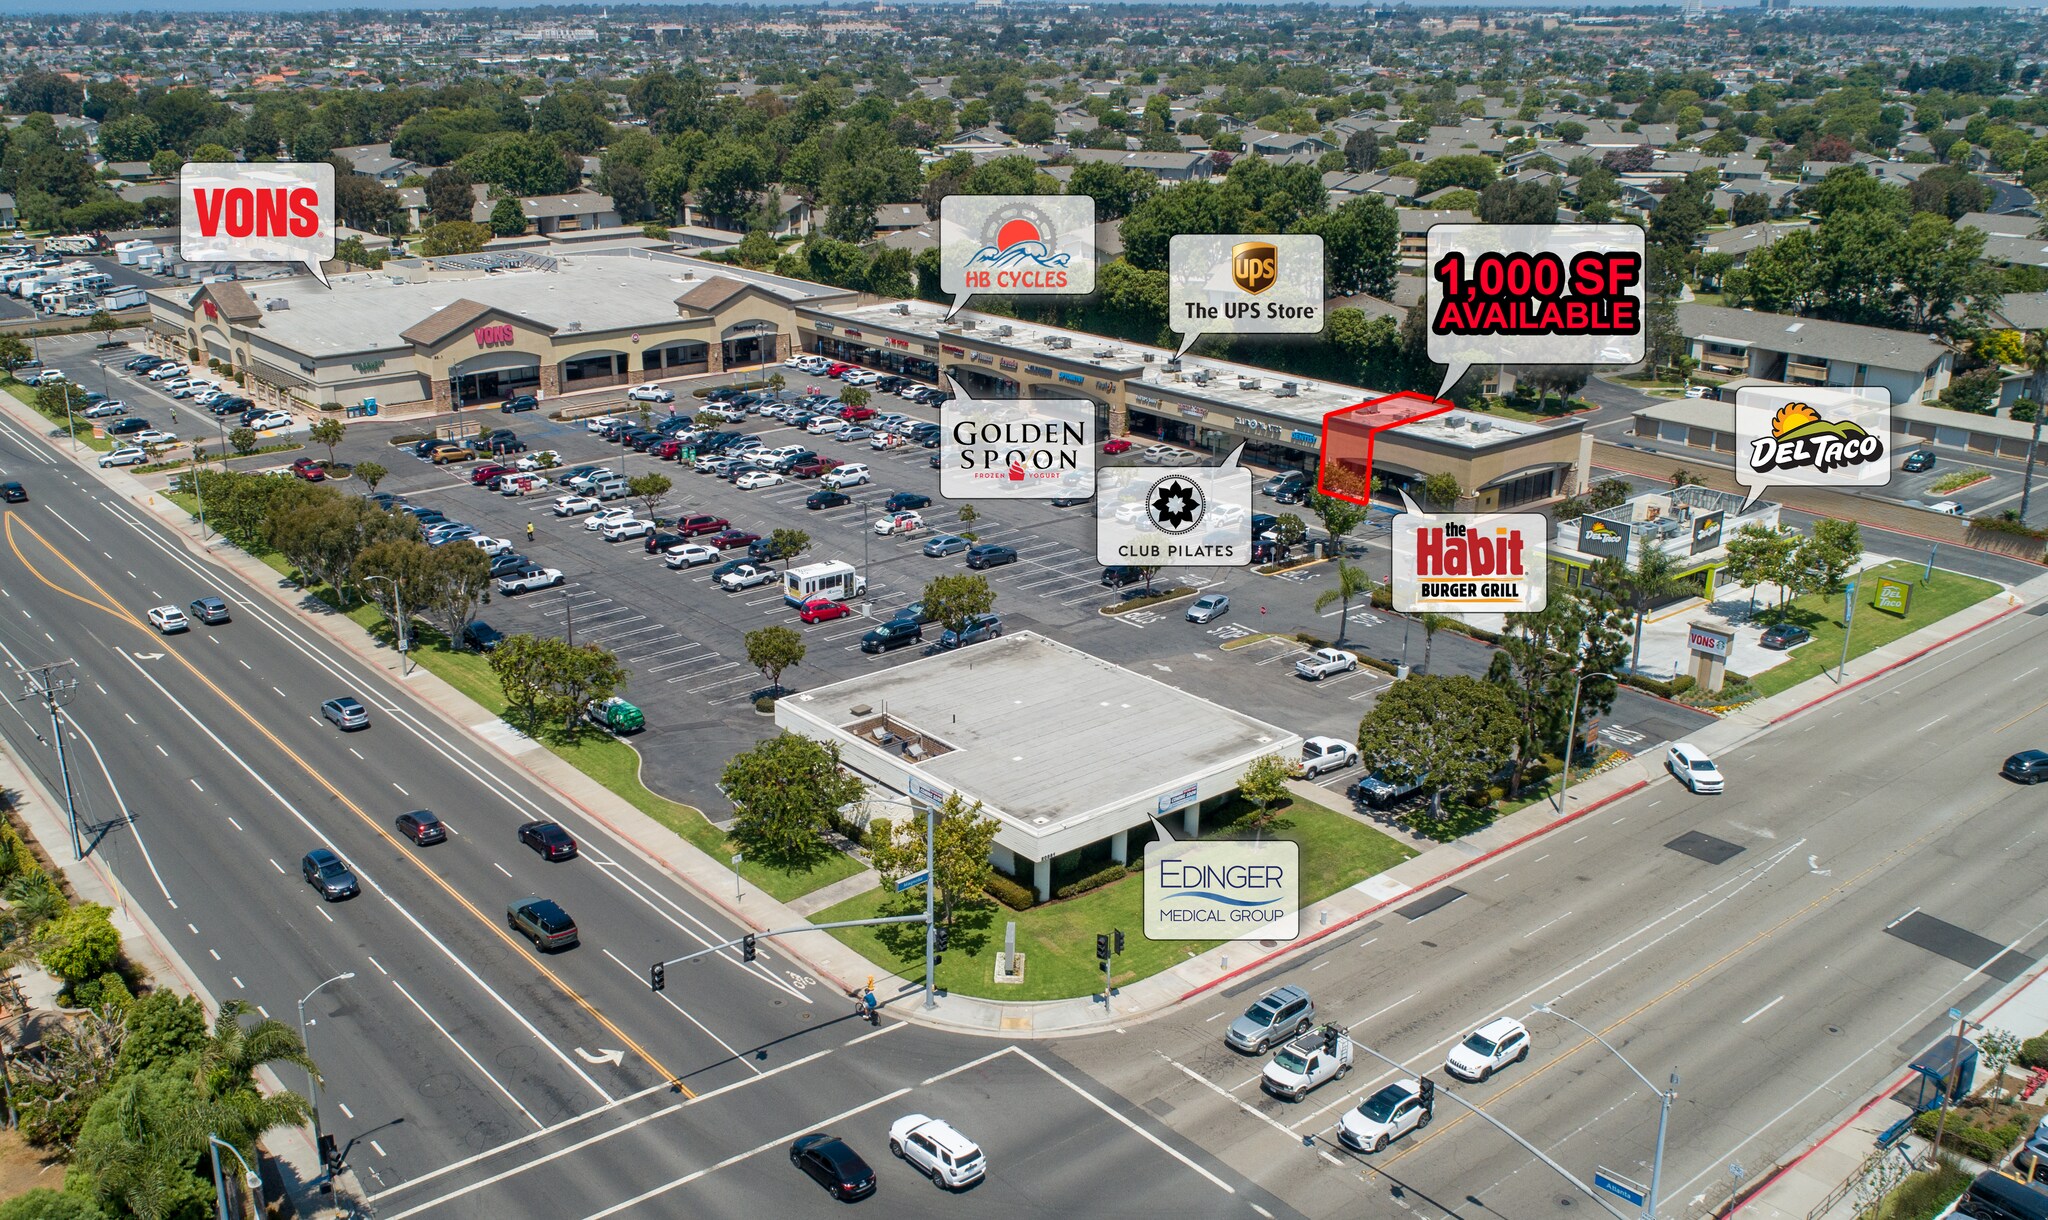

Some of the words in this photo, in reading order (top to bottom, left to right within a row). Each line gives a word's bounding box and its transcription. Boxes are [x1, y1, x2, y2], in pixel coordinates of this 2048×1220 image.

[474, 324, 514, 346] VONS
[1691, 633, 1715, 649] VONS
[1606, 1183, 1632, 1199] Atlanta
